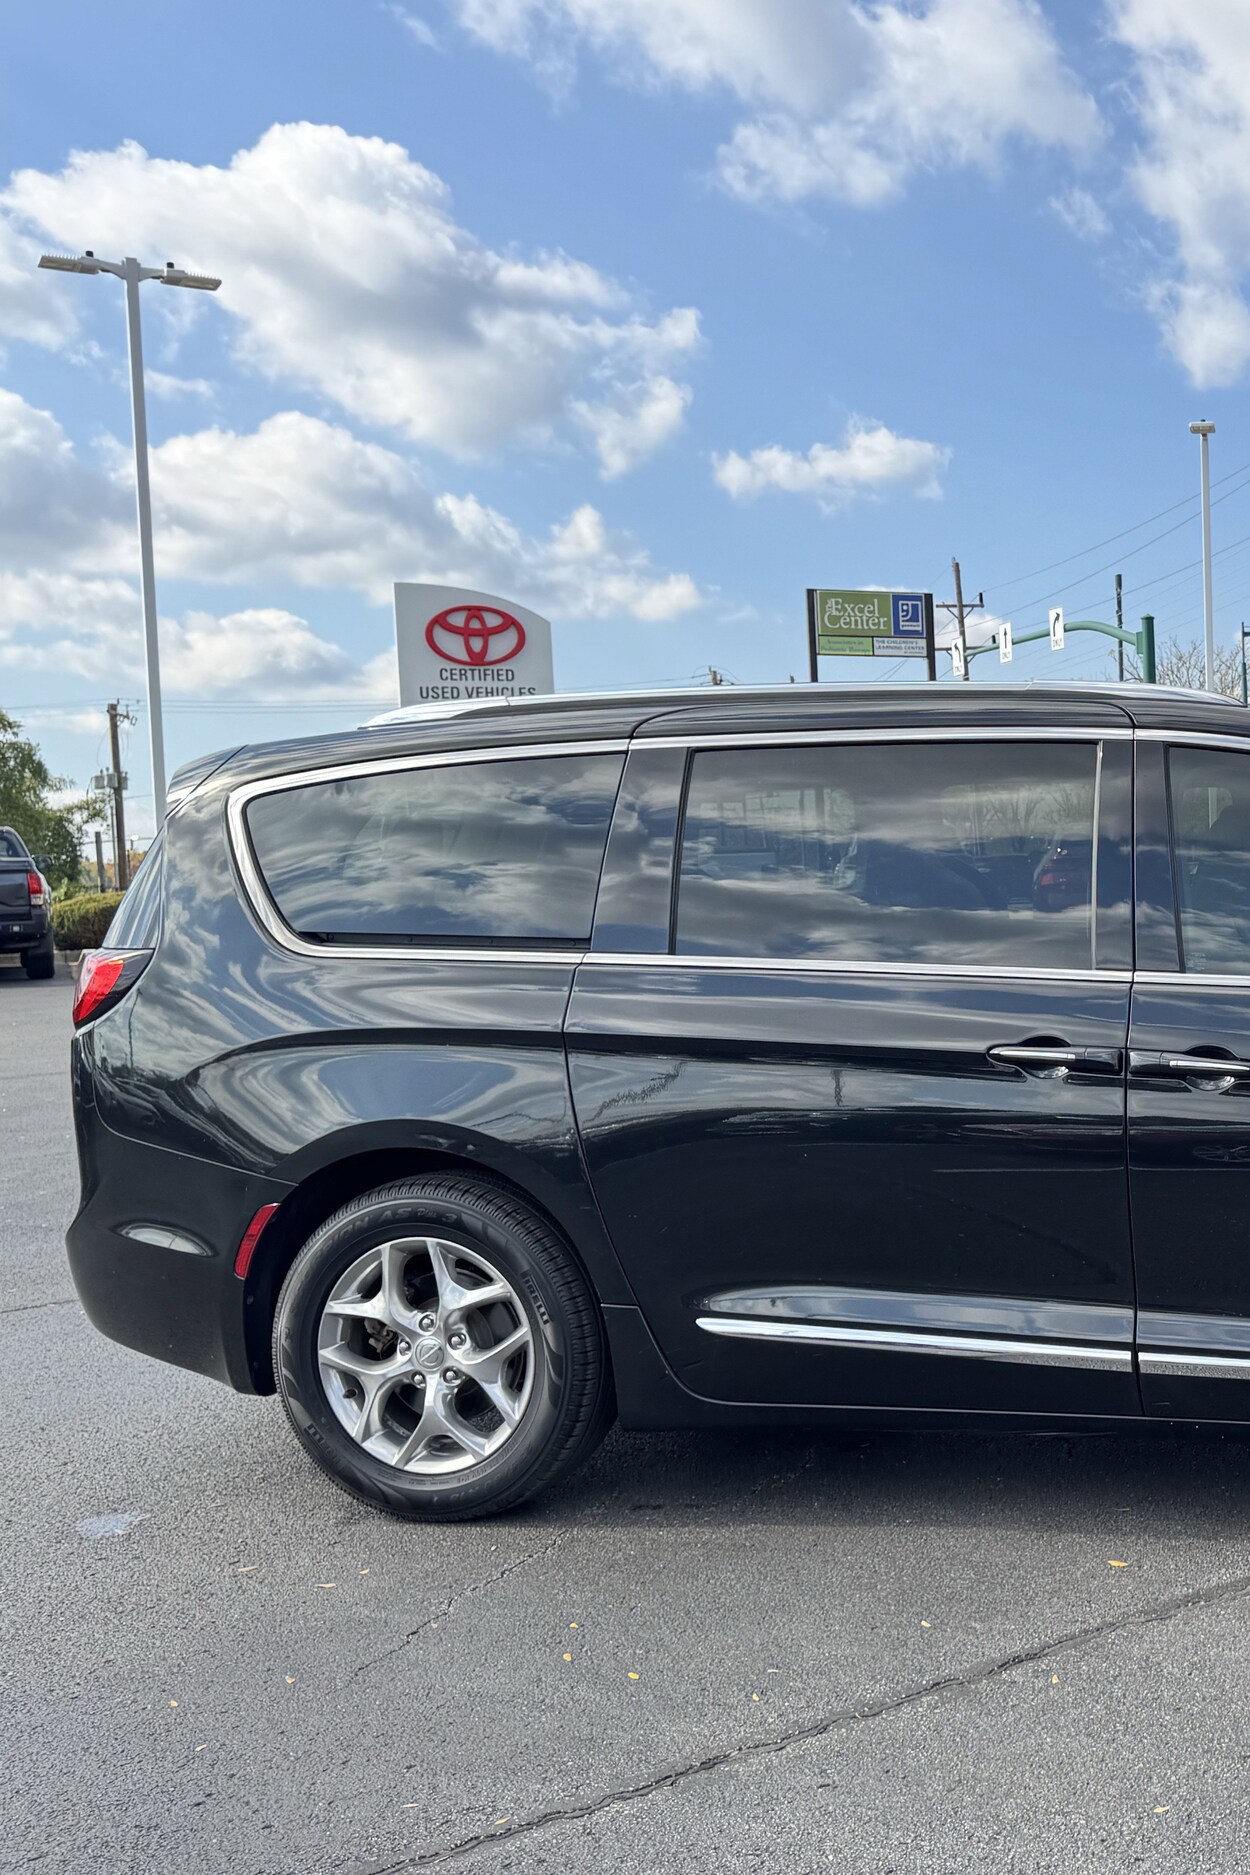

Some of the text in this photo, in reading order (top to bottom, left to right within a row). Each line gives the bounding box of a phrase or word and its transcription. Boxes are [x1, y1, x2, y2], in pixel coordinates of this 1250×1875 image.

[830, 598, 880, 617] Excel
[824, 610, 888, 630] Center
[439, 667, 515, 682] CERTIFIED
[419, 686, 460, 699] USED
[521, 1269, 552, 1325] PIRELLI
